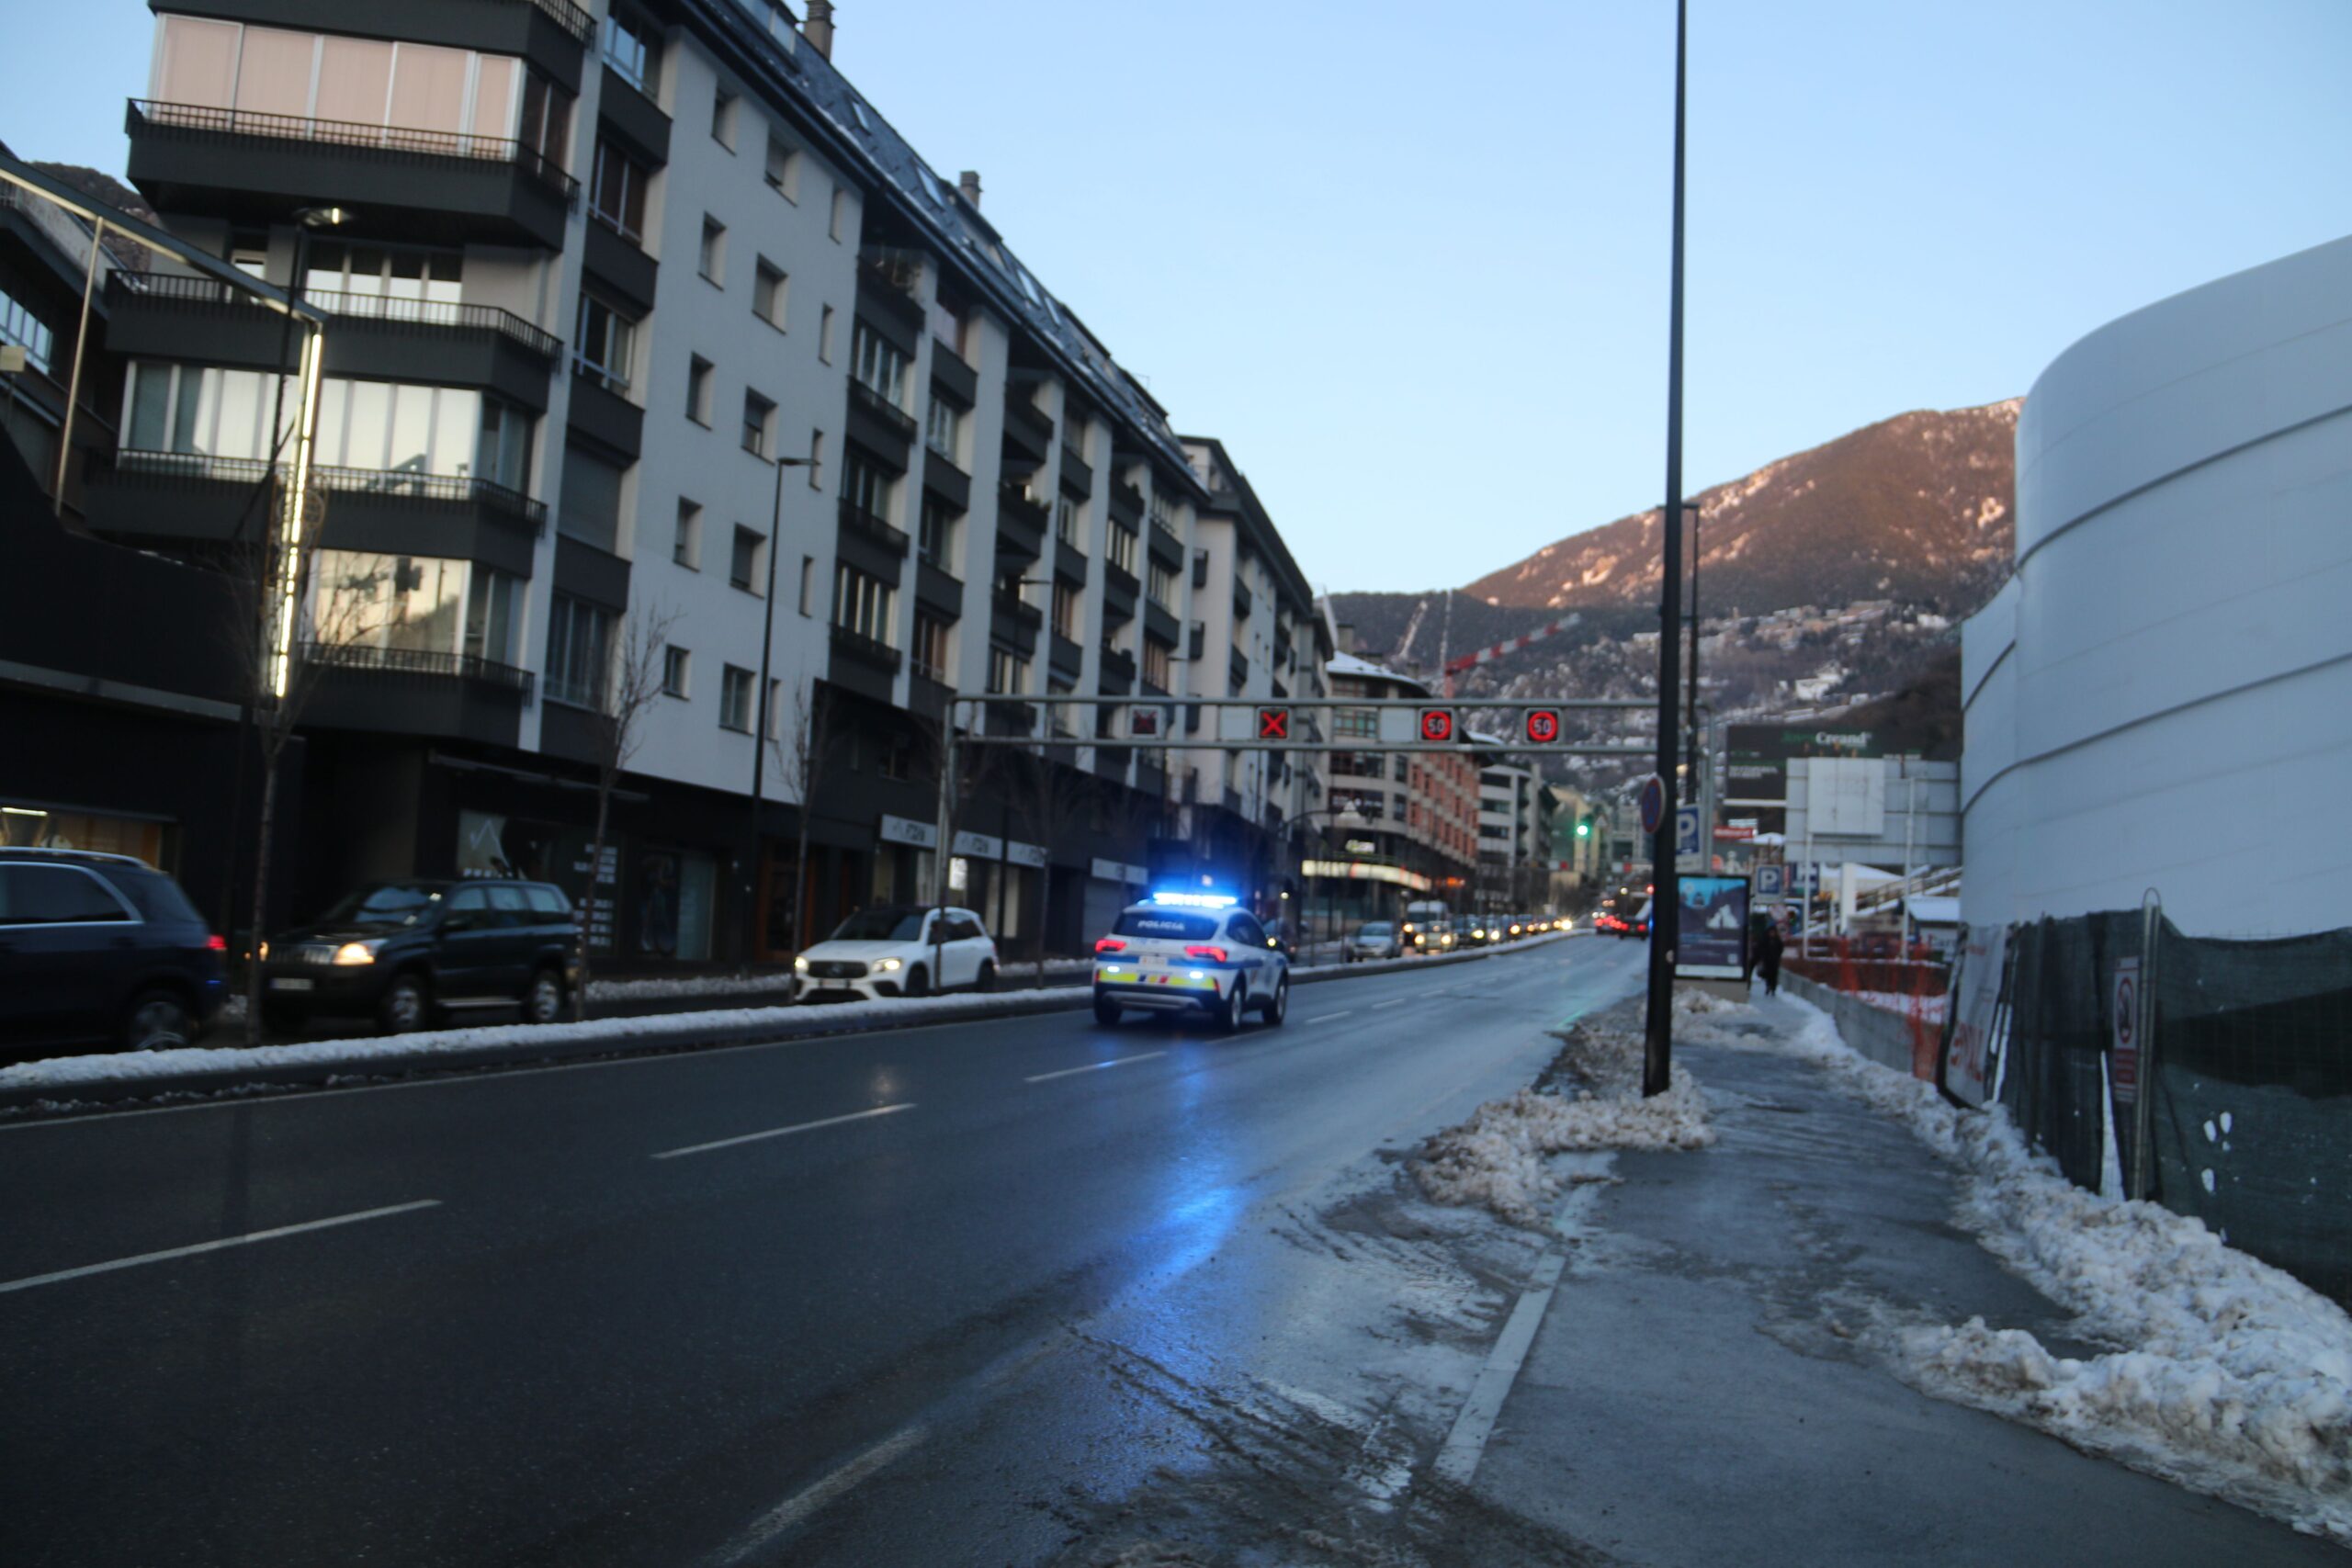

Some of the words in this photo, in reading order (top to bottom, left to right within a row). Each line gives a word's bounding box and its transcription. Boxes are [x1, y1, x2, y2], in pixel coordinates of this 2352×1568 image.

[1428, 718, 1445, 733] 50
[1533, 718, 1552, 734] 50
[1815, 731, 1867, 746] Creand
[1676, 812, 1696, 850] P
[1760, 870, 1778, 893] P
[1137, 919, 1185, 931] POLICIA
